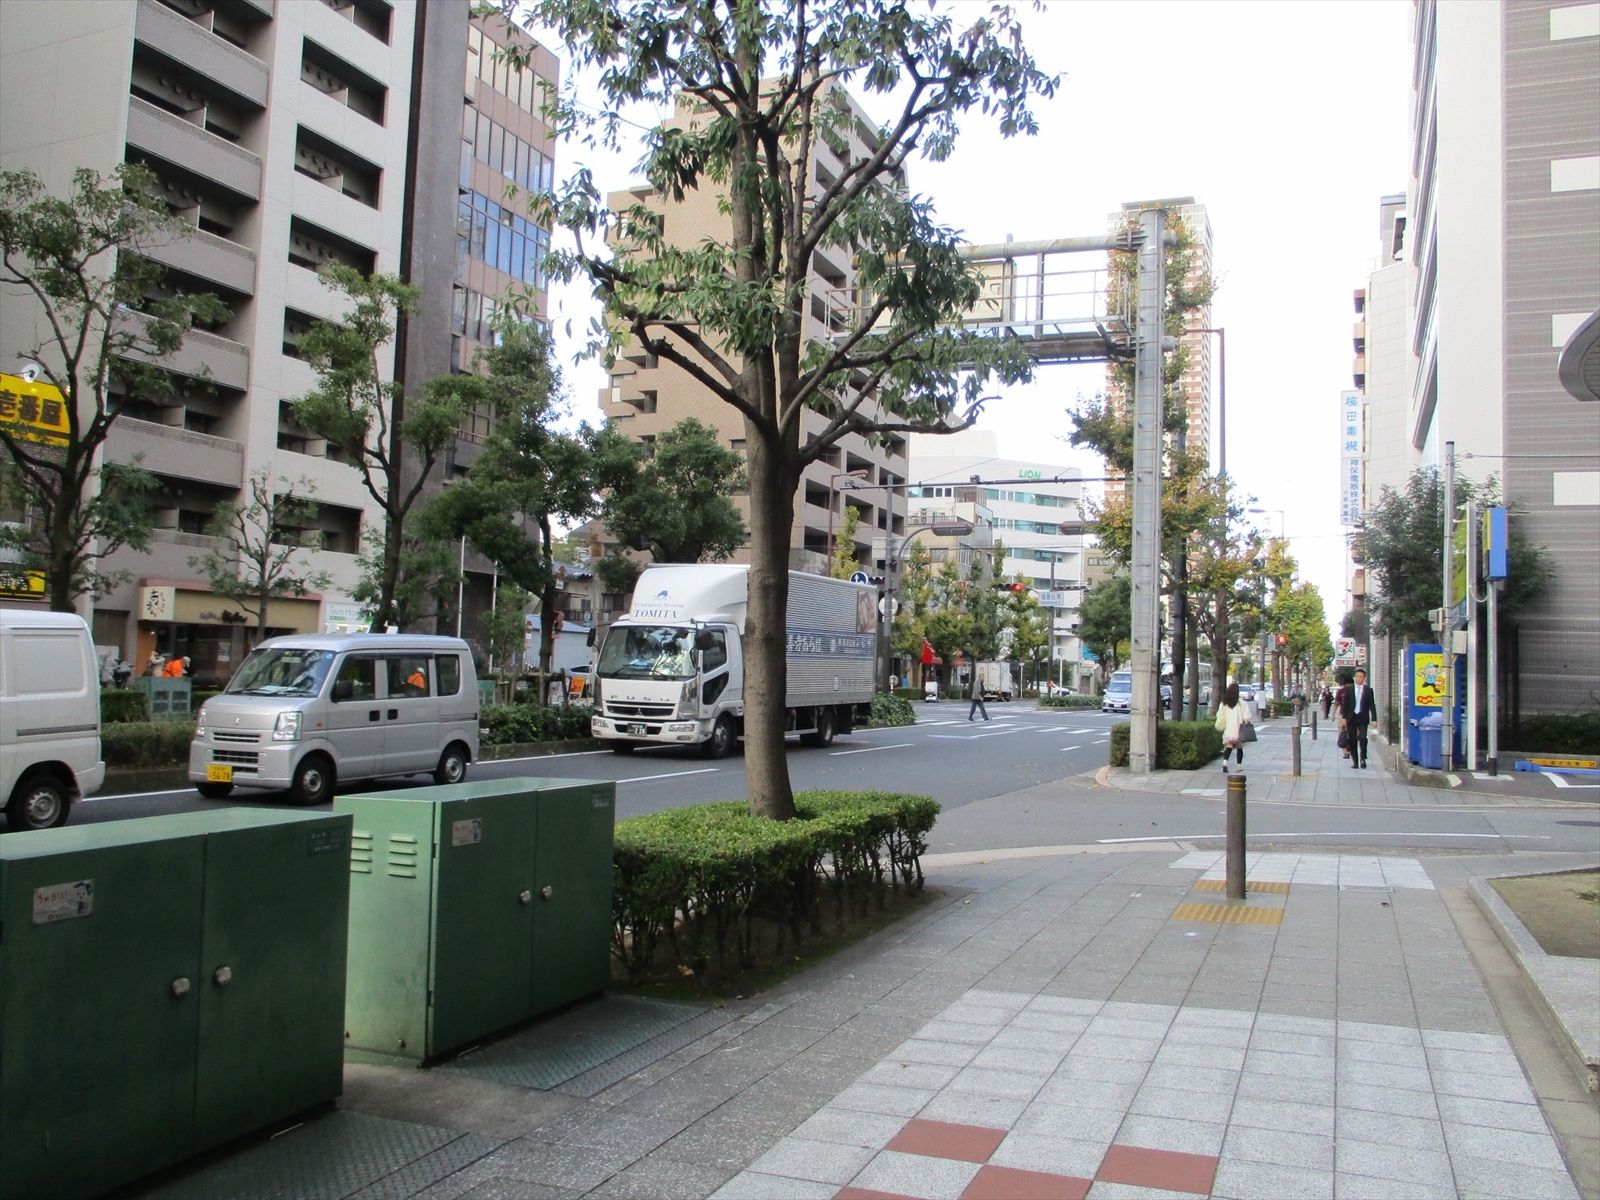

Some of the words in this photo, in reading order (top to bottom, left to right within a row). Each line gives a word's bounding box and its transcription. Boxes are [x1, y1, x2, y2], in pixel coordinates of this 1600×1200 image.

[1018, 468, 1041, 479] LION
[635, 609, 677, 619] TOMITA
[611, 694, 670, 702] FUSO
